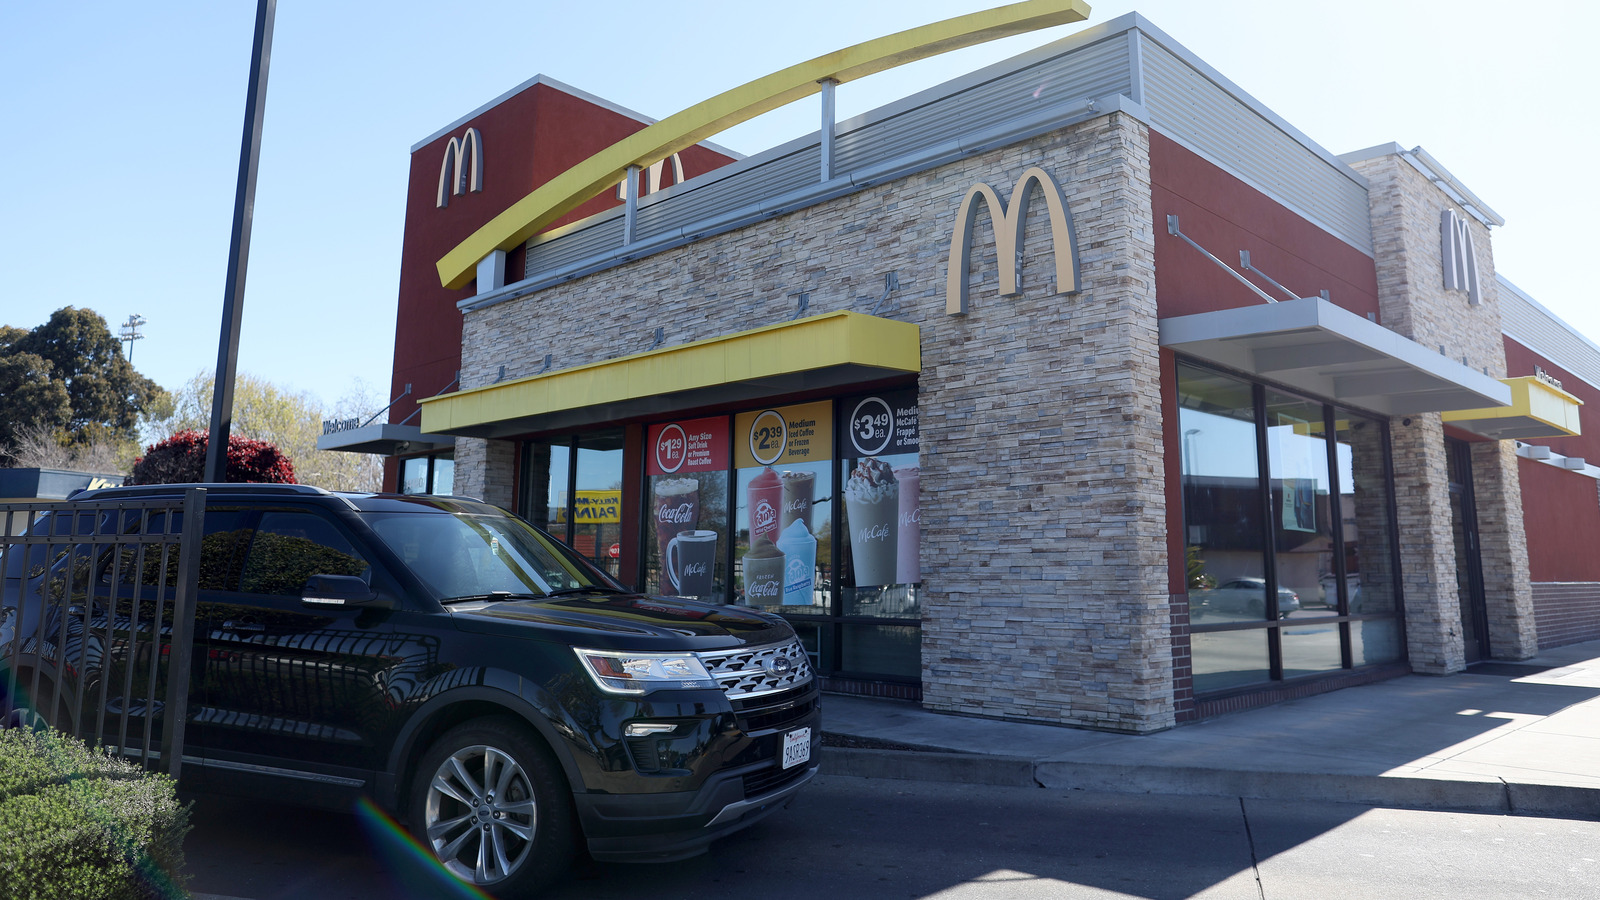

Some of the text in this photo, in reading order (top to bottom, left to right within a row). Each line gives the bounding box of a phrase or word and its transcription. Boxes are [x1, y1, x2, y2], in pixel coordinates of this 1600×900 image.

[322, 417, 360, 436] Welcome
[788, 419, 816, 429] Medium
[788, 428, 815, 438] Iced Coffee
[874, 428, 886, 439] ea.
[896, 426, 916, 437] Frappé
[688, 432, 713, 443] Any Size
[903, 437, 920, 446] Smoo
[687, 441, 708, 450] Soft Drink
[770, 440, 780, 449] ea.
[692, 449, 710, 458] Premium
[788, 447, 810, 457] Beverage
[687, 457, 712, 467] Roast Coffee
[783, 498, 807, 513] McCafé
[658, 502, 694, 524] Coca-Cola
[858, 523, 889, 544] McCafé
[683, 561, 707, 577] McCafé
[748, 580, 780, 598] Coca-Cola
